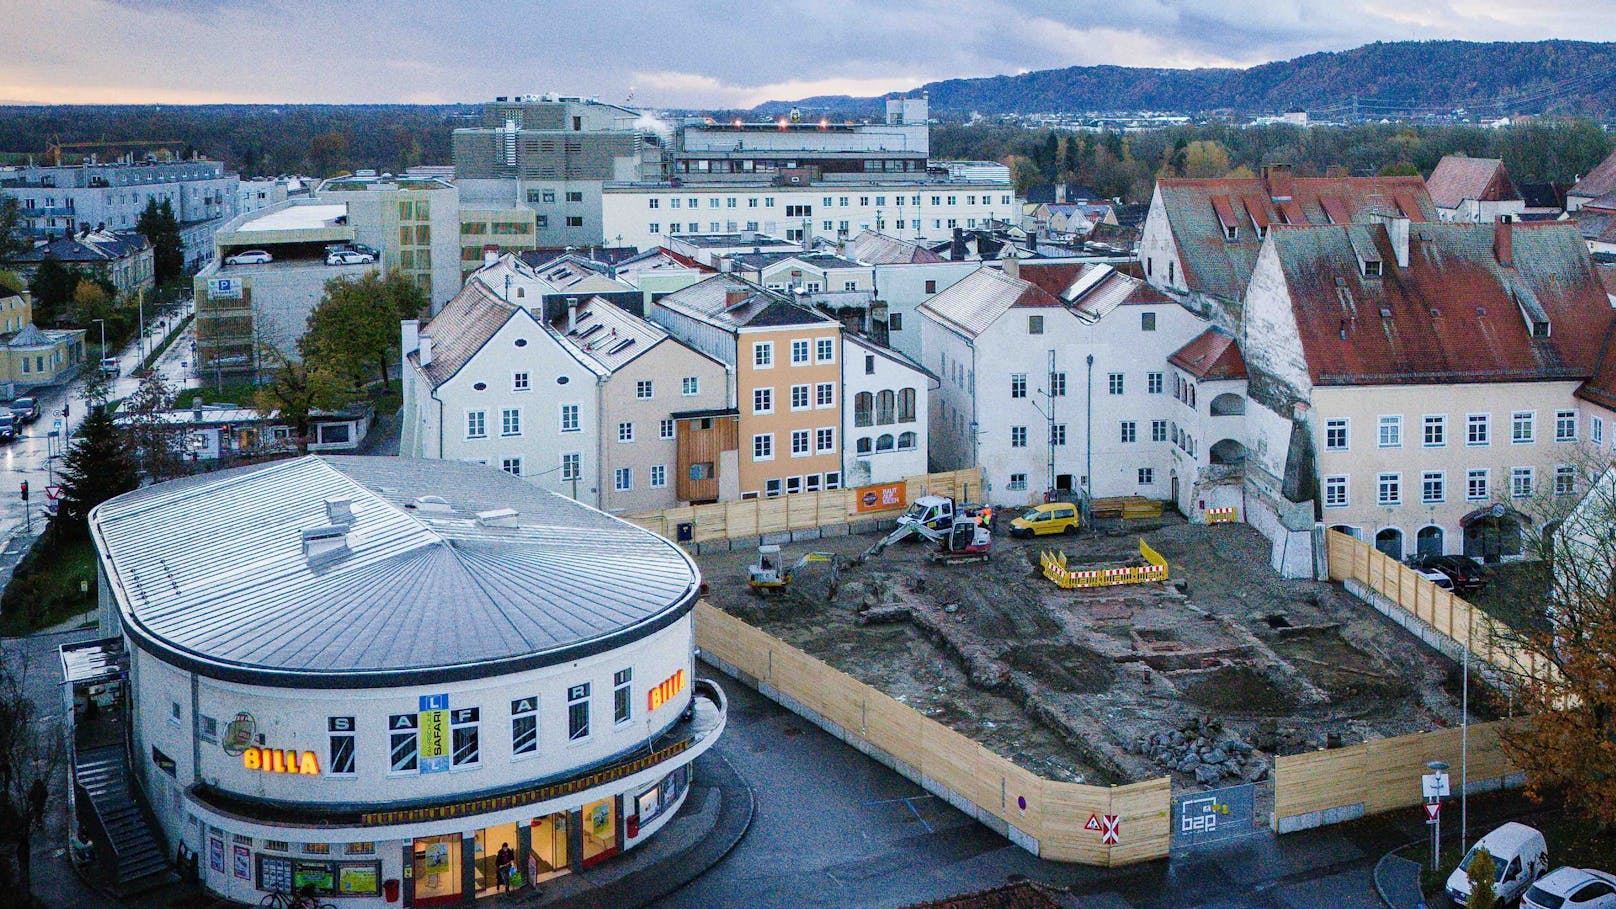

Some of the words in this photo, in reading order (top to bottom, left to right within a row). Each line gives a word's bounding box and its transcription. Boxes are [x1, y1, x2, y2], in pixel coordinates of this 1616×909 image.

[648, 669, 684, 711] BILLA
[433, 711, 442, 756] SAFARI
[244, 746, 319, 775] BILLA
